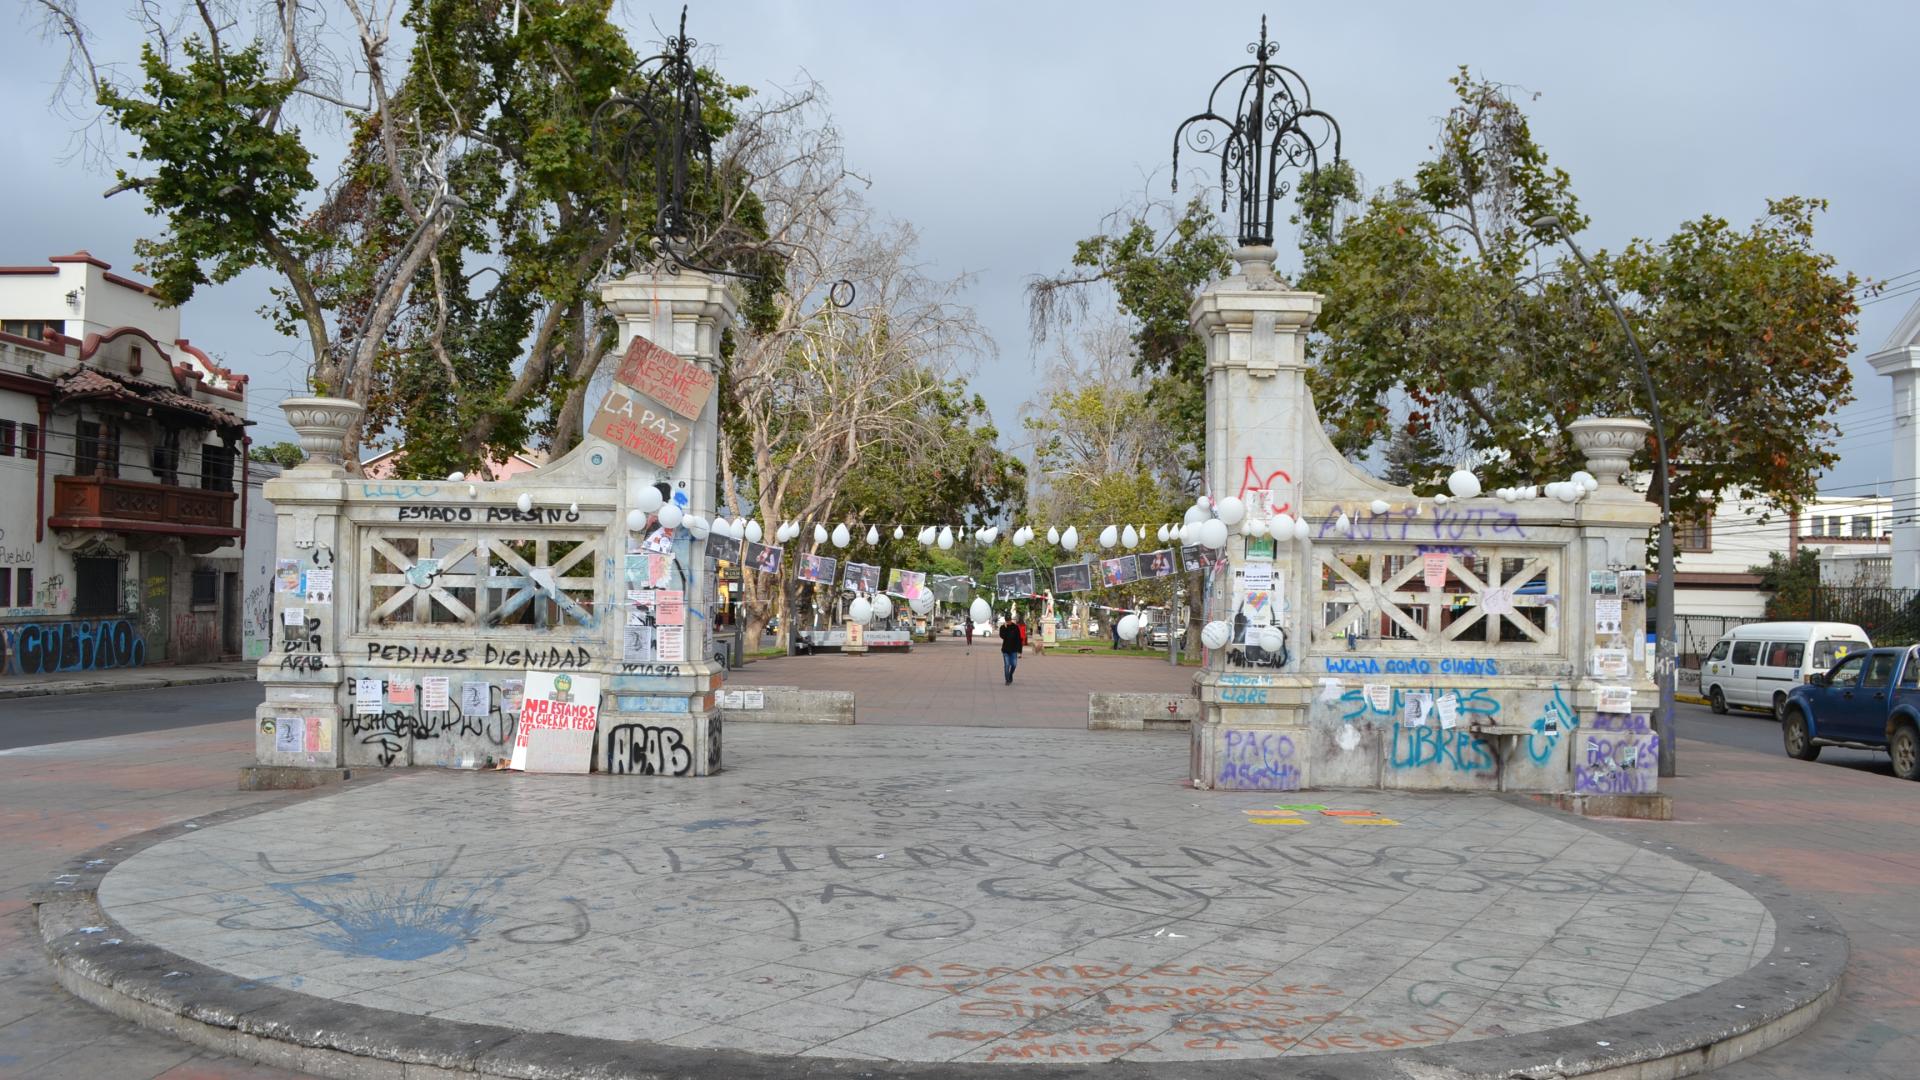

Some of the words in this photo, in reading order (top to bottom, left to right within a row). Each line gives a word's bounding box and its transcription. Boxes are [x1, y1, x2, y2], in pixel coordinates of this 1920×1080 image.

[625, 351, 691, 398] PRESENTE
[657, 387, 698, 416] SIEMPRE
[604, 392, 632, 418] LA
[640, 410, 680, 442] PAZ
[620, 417, 638, 432] SIN
[606, 424, 624, 441] ES
[624, 432, 676, 466] IMPUNIDAD
[399, 507, 472, 523] ESTADO
[486, 507, 580, 524] ASESINO
[368, 642, 467, 663] PEDIMOS
[484, 643, 591, 667] DIGNIDAD
[1326, 657, 1379, 674] LUCHA
[525, 698, 549, 714] NO
[551, 701, 596, 718] ESTAMOS
[521, 710, 534, 724] EN
[536, 713, 569, 728] GUERRA
[572, 716, 596, 731] PERO
[608, 723, 691, 776] ACAB
[1225, 730, 1296, 760] PACO
[663, 843, 1551, 873] BIENVENIDOS
[886, 962, 1276, 980] ASAMBLEAS
[959, 1000, 1071, 1018] SIN
[986, 1040, 1163, 1062] ARRIBA
